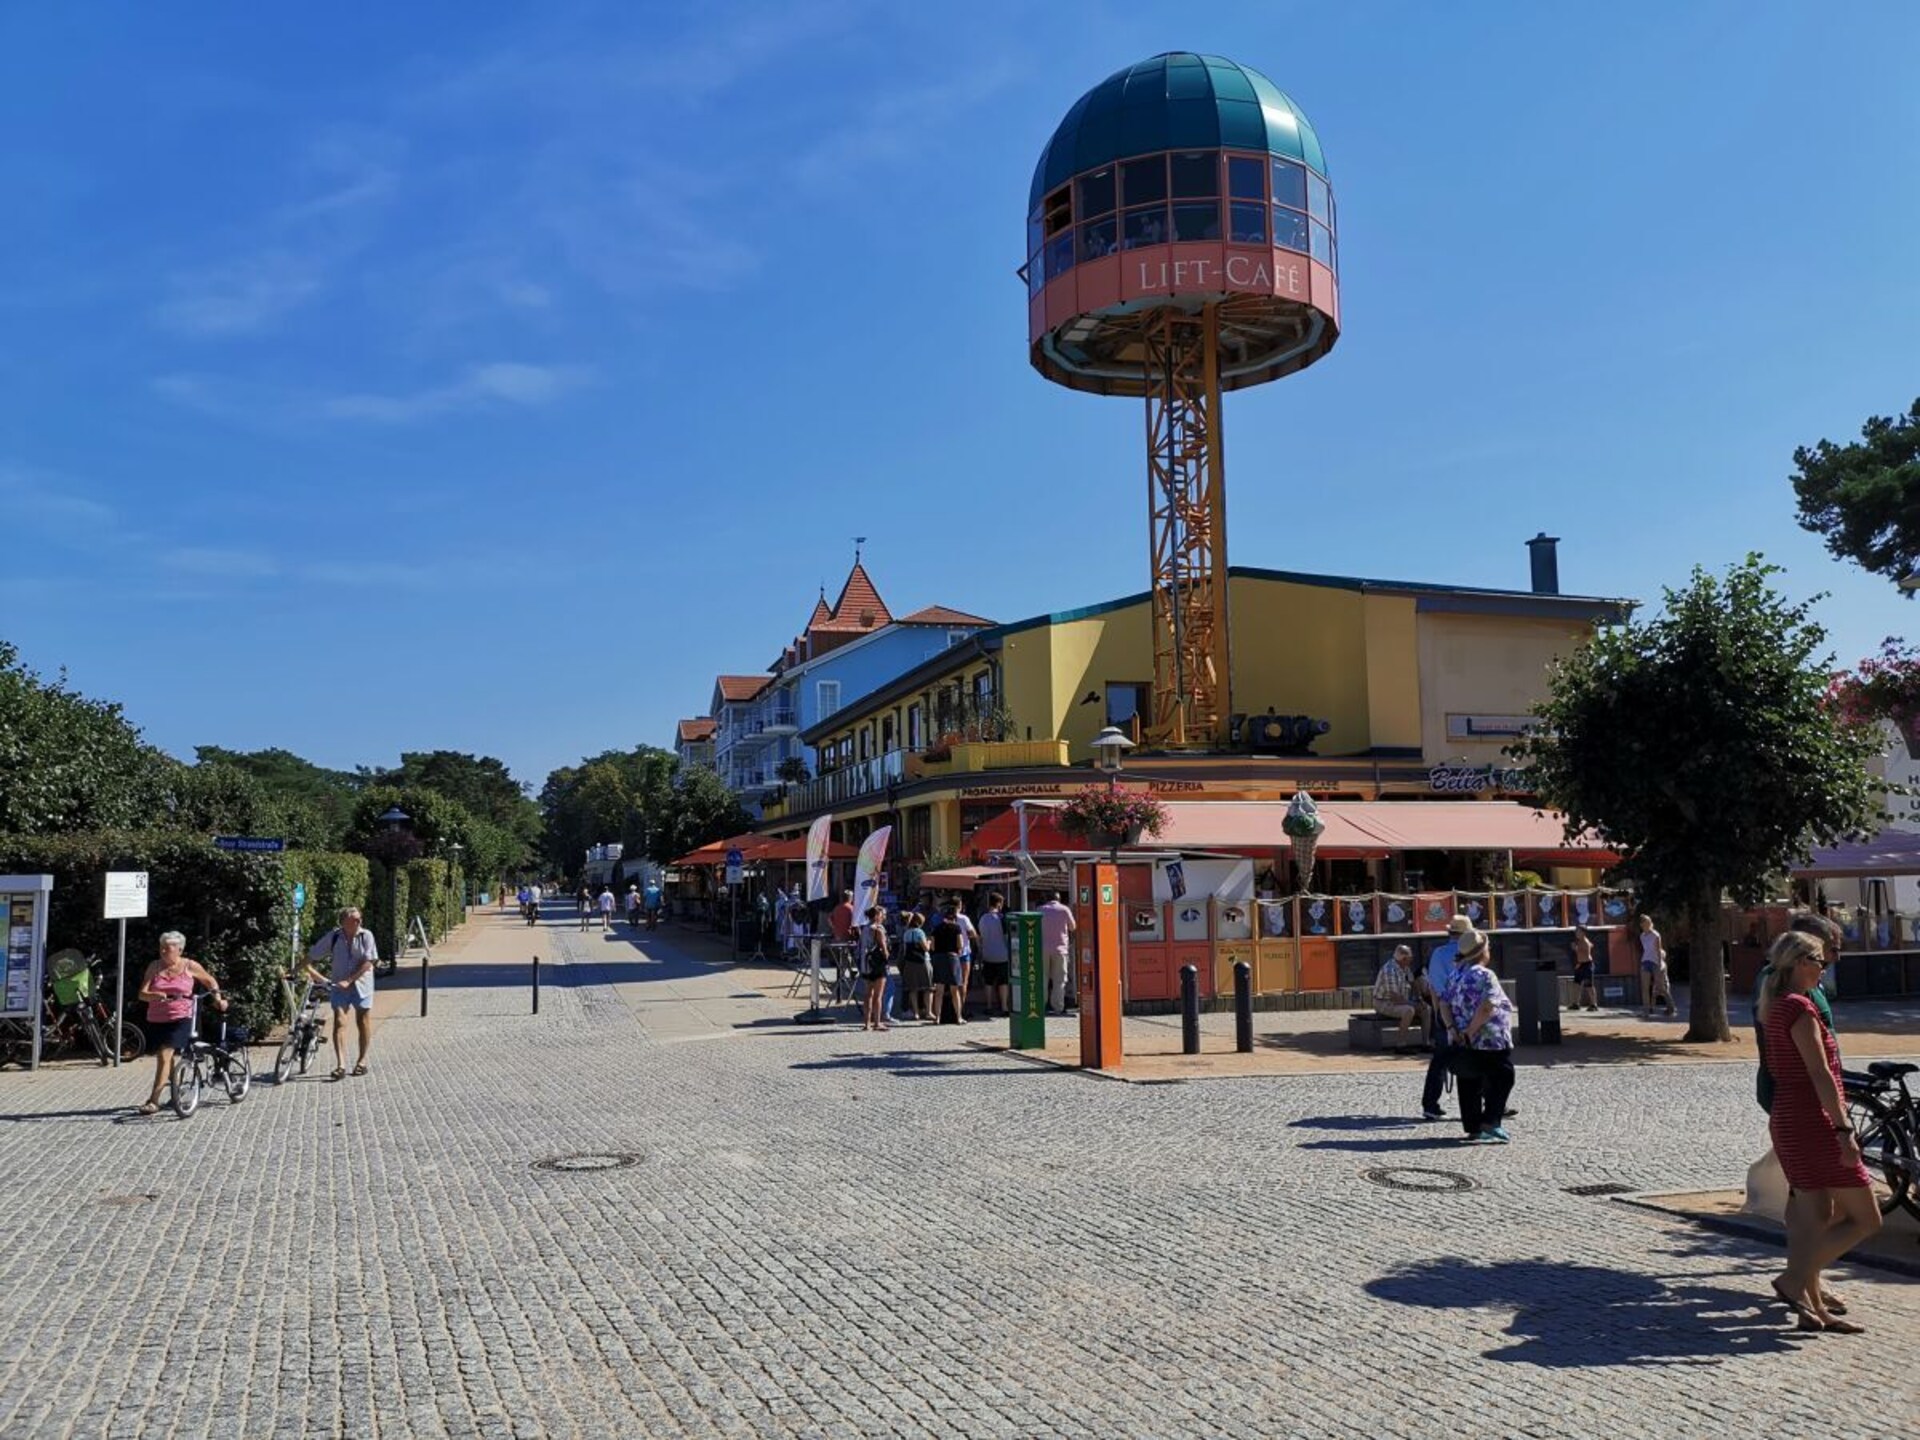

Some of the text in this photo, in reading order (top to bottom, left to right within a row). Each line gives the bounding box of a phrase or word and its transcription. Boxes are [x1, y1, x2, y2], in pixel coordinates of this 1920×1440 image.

[1149, 781, 1204, 793] PIZZERIA
[1430, 767, 1486, 792] Bella
[962, 784, 1061, 797] PROMENADENHALLE
[1027, 928, 1036, 1010] KURKARTEN
